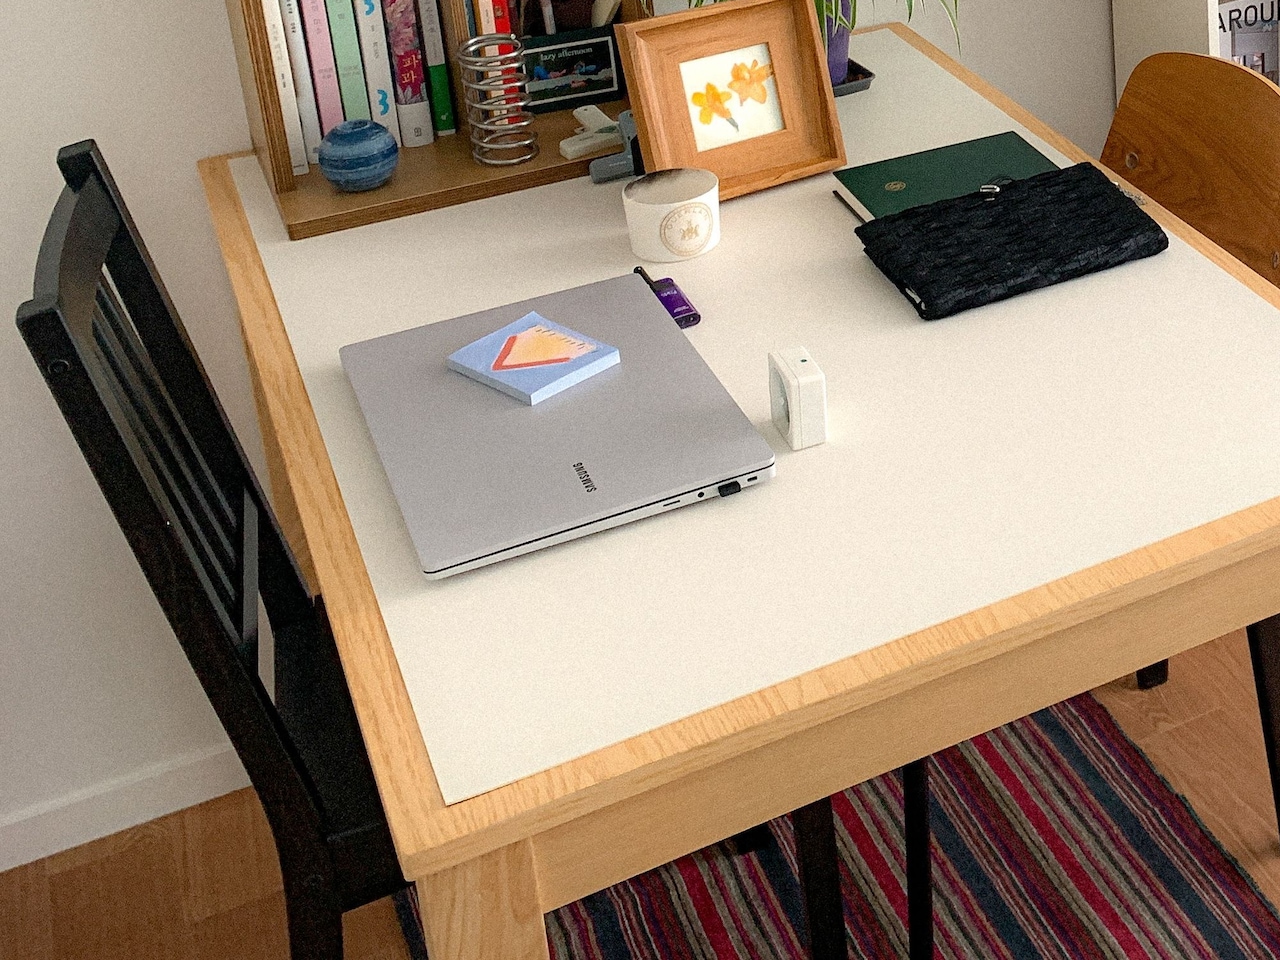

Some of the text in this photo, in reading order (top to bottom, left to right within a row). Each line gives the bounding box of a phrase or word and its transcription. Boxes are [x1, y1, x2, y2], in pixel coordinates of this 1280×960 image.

[540, 47, 593, 62] lazy afternoon
[572, 462, 598, 493] SAMSUNG
